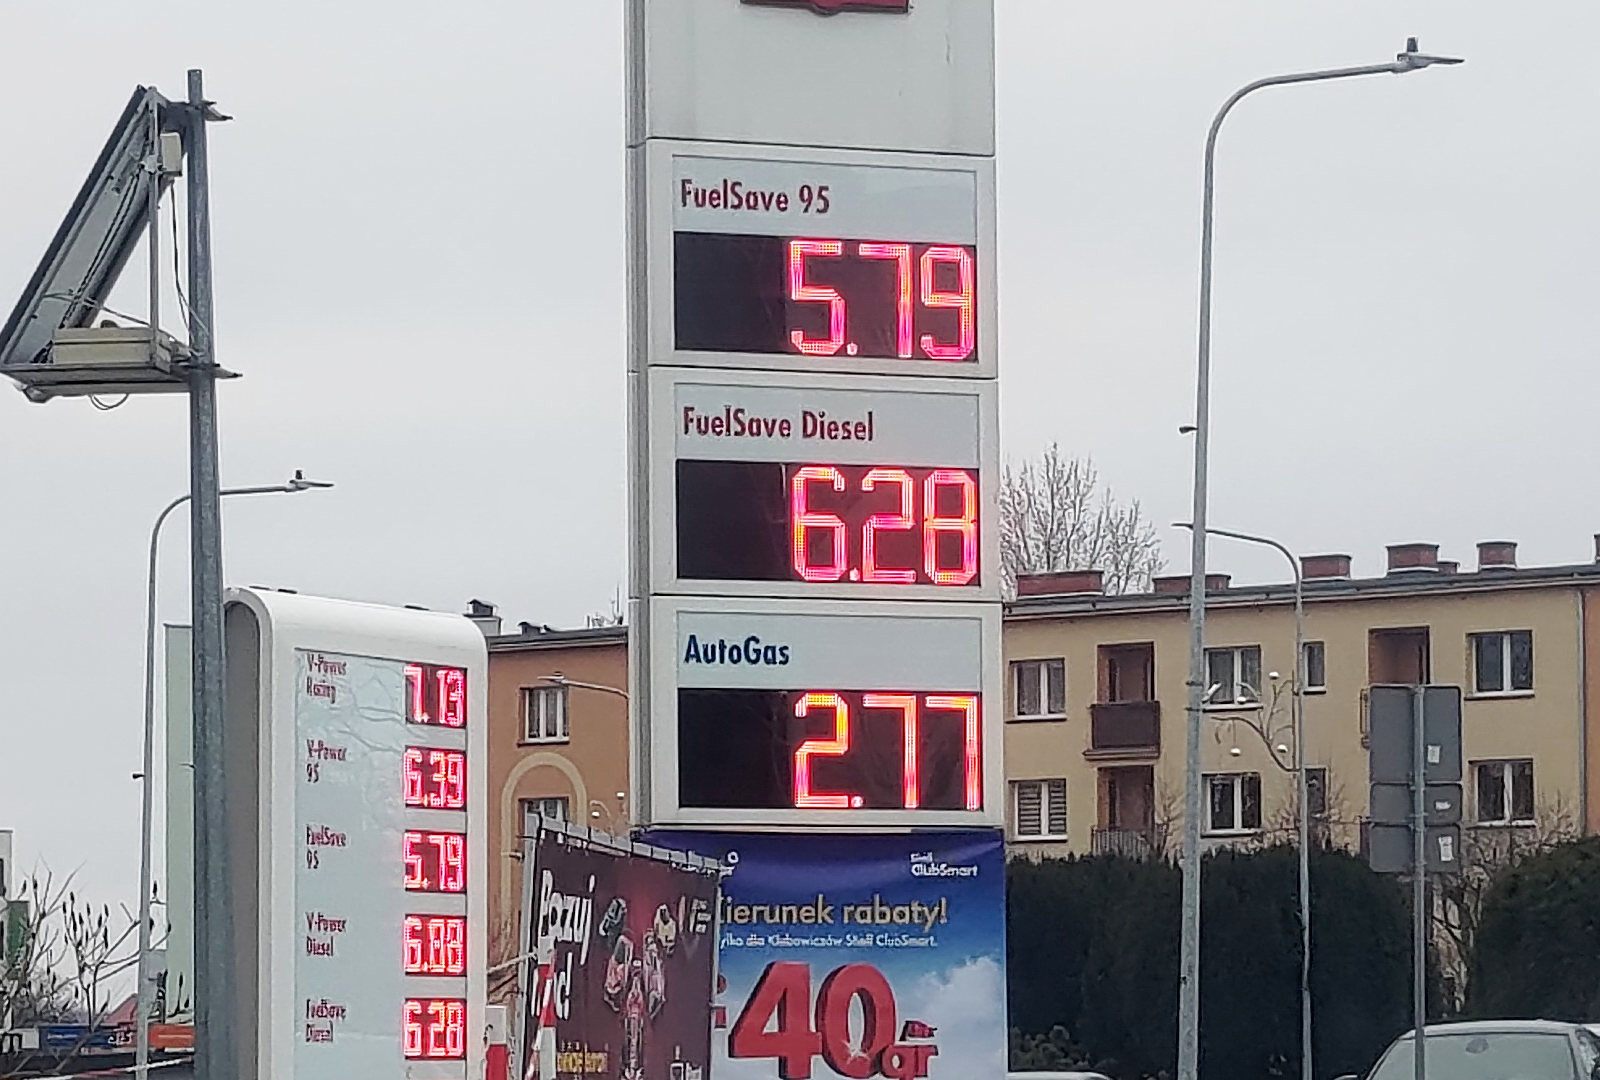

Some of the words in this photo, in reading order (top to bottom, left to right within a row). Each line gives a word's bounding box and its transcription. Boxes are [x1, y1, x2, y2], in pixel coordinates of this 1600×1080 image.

[681, 178, 789, 213] FuelSave
[799, 185, 831, 214] 95
[787, 239, 976, 360] 5.79
[683, 406, 792, 438] FuelSave
[802, 411, 875, 442] Diesel
[792, 465, 978, 586] 6.28
[684, 634, 790, 666] AutoGas
[306, 739, 348, 762] V-Power
[794, 691, 980, 810] 2.77
[306, 763, 320, 783] 95
[404, 748, 465, 808] 6.39
[306, 824, 348, 847] FuelSave
[306, 849, 320, 869] 95
[403, 832, 465, 892] 5.79
[910, 863, 979, 877] ClubSmart
[305, 911, 348, 934] V-Power
[843, 893, 948, 933] rabaty!
[306, 936, 334, 957] Diesel
[728, 960, 896, 1079] 40
